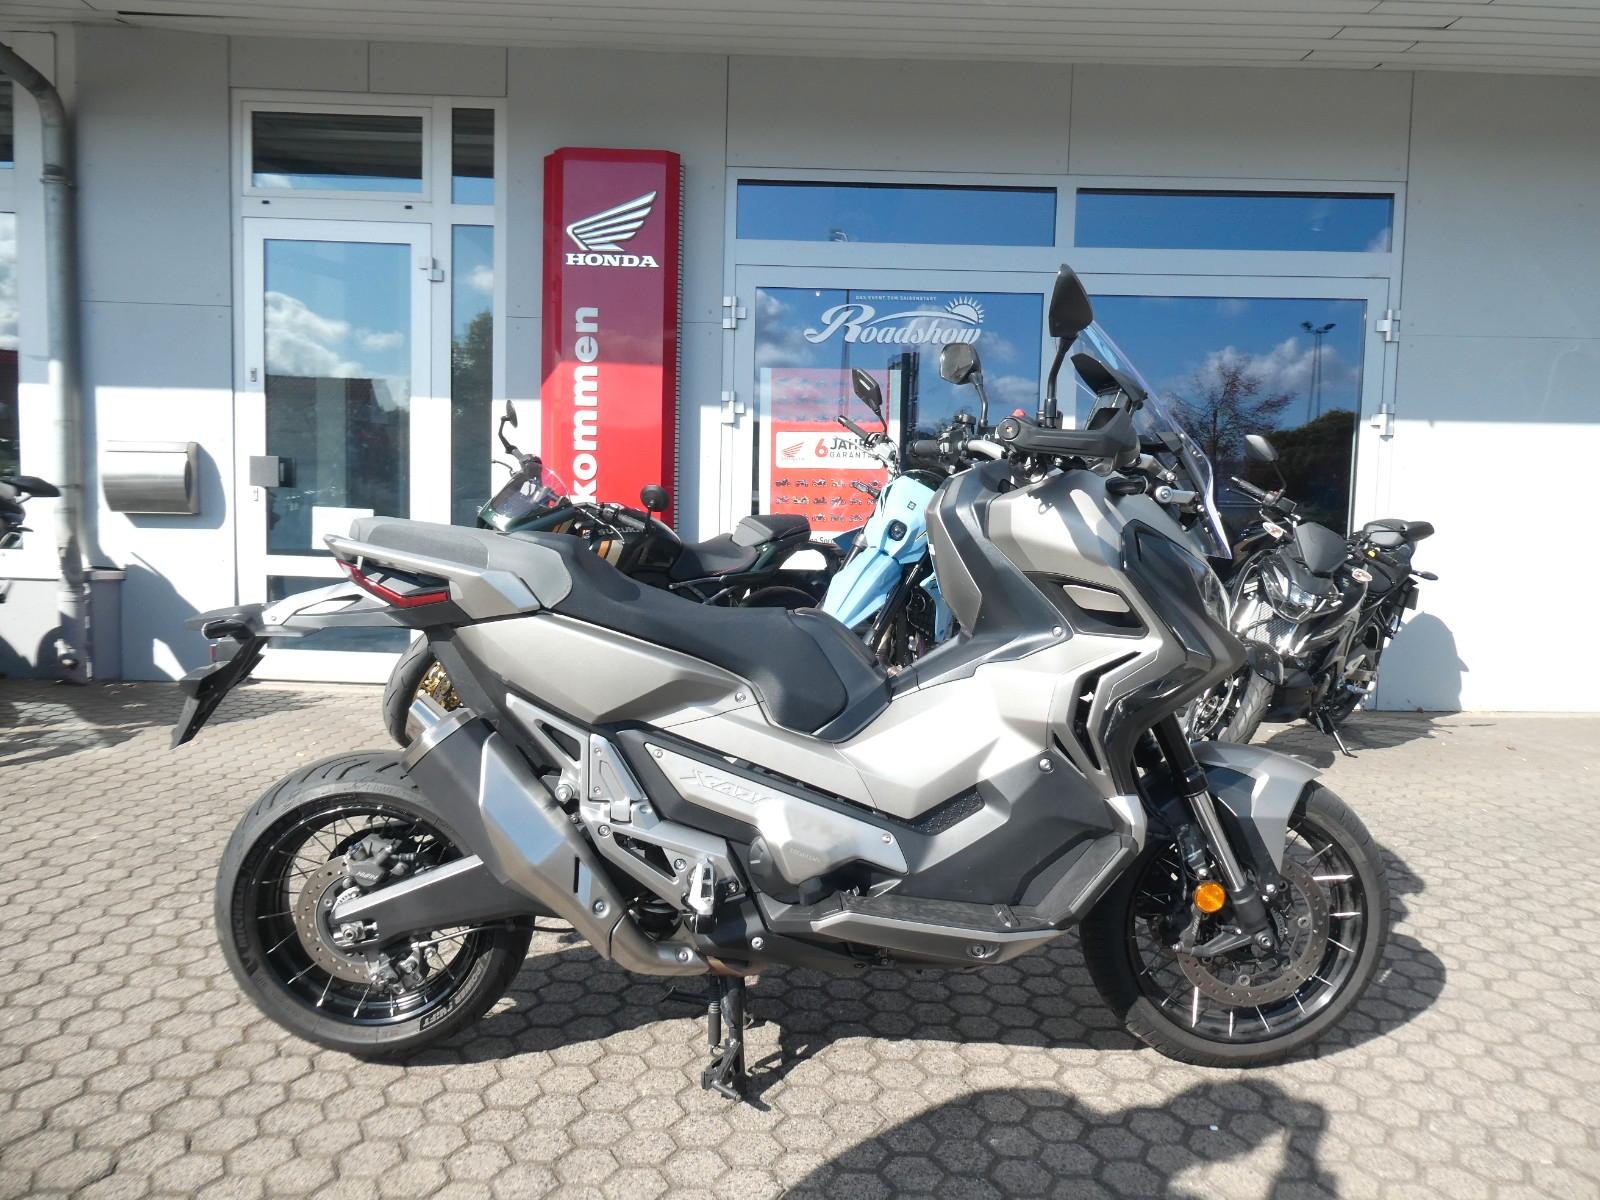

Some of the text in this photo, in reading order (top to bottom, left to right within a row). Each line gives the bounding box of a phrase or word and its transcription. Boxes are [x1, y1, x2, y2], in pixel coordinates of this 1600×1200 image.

[565, 253, 660, 268] HONDA
[803, 303, 982, 344] Roadshow
[815, 438, 829, 458] 6
